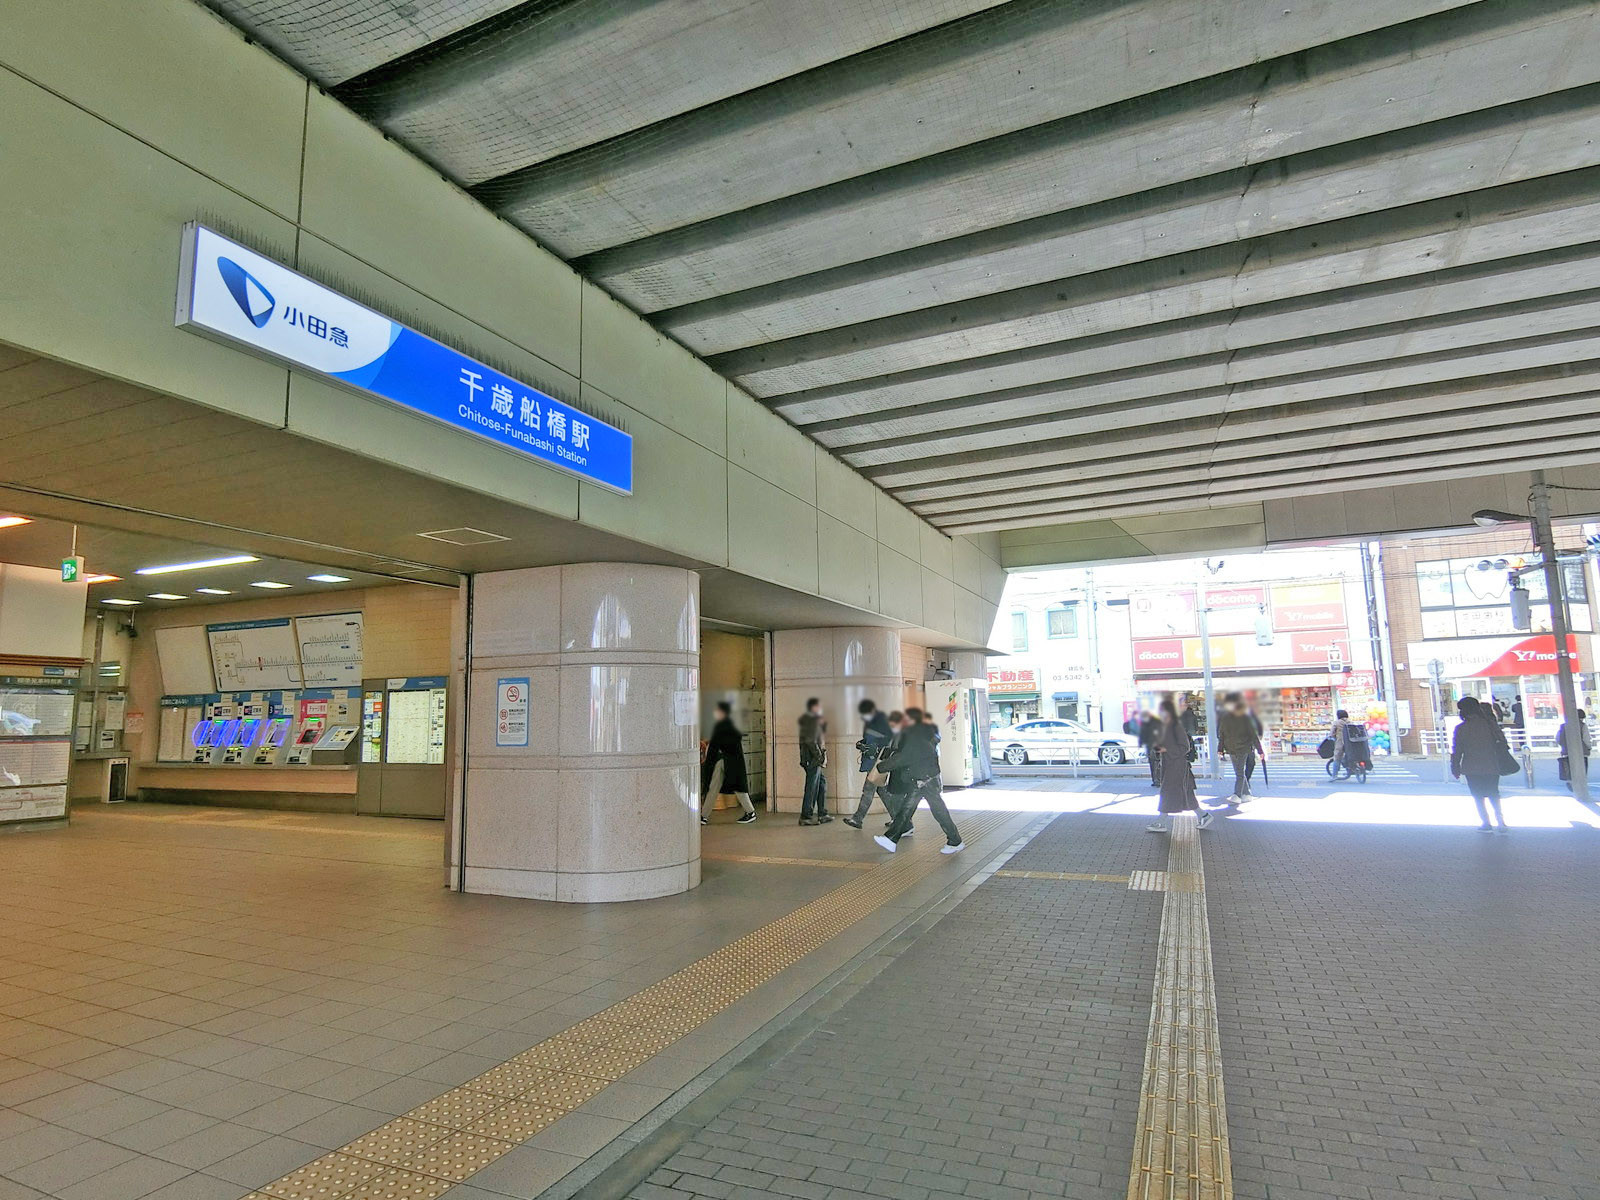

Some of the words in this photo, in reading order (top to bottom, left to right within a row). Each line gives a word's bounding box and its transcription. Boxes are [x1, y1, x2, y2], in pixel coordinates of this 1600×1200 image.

[283, 305, 350, 350] 小田急
[459, 367, 590, 452] 千歳船橋駅
[458, 403, 555, 454] Chitose-Funabashi
[556, 445, 587, 467] Station
[1207, 594, 1257, 605] docomo
[1139, 650, 1179, 660] docomo
[1510, 650, 1577, 662] Y!moe
[986, 669, 1035, 682] 不動産
